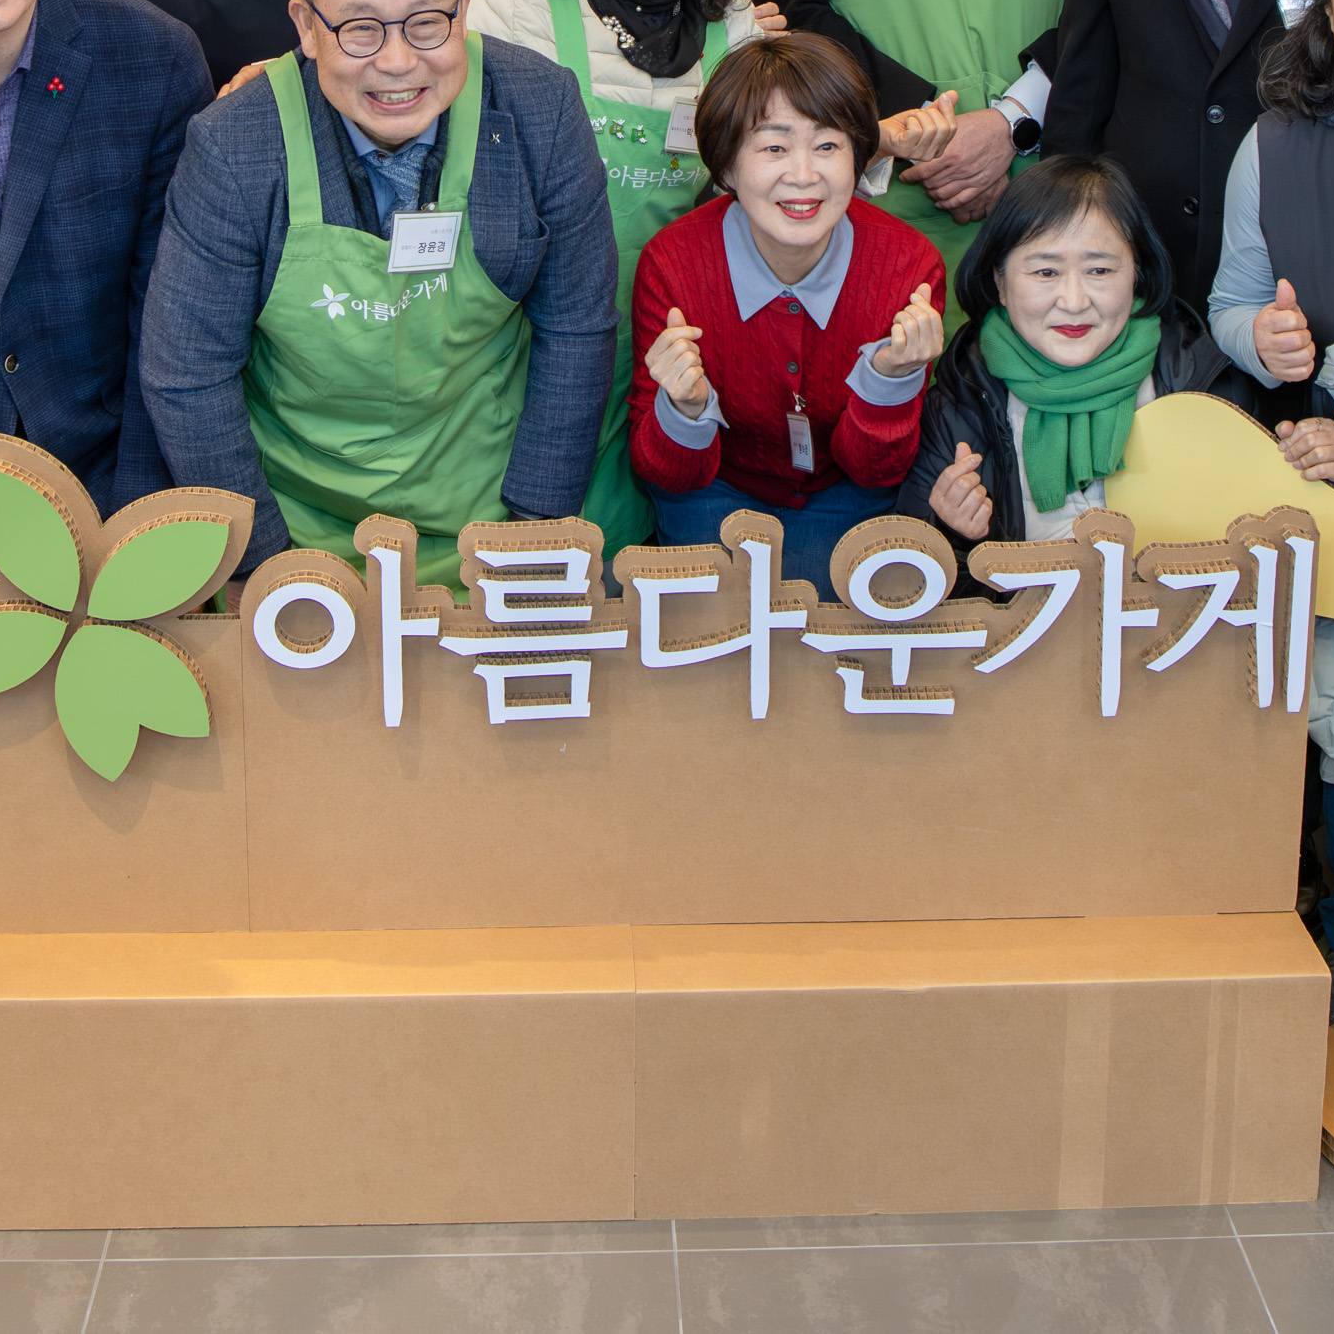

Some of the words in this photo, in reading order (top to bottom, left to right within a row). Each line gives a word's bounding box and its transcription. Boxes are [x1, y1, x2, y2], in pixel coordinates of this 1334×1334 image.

[418, 241, 446, 254] 장윤경
[350, 272, 449, 322] 아름다운가게
[254, 532, 1315, 727] 아름다운가게
